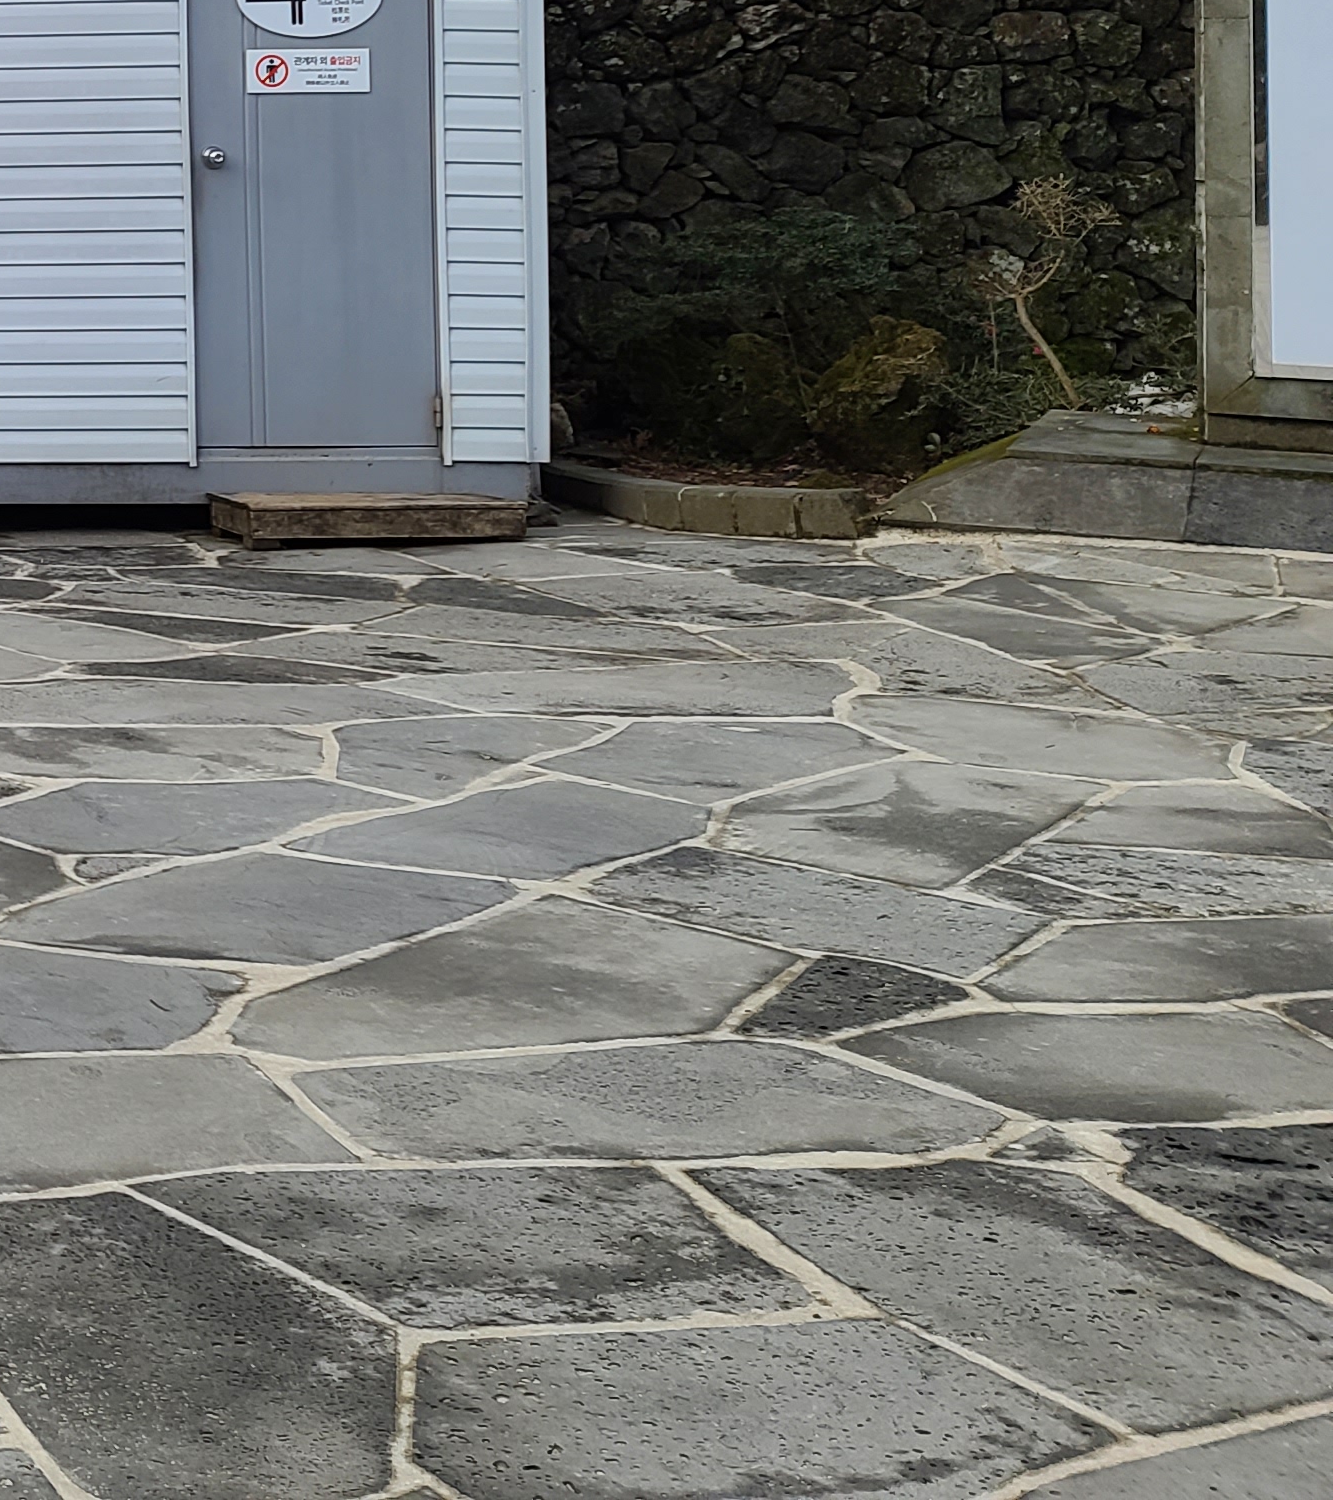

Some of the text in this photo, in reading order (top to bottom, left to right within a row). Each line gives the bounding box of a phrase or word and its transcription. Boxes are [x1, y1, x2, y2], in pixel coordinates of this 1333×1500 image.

[293, 55, 362, 66] 관계자 외 출입금지
